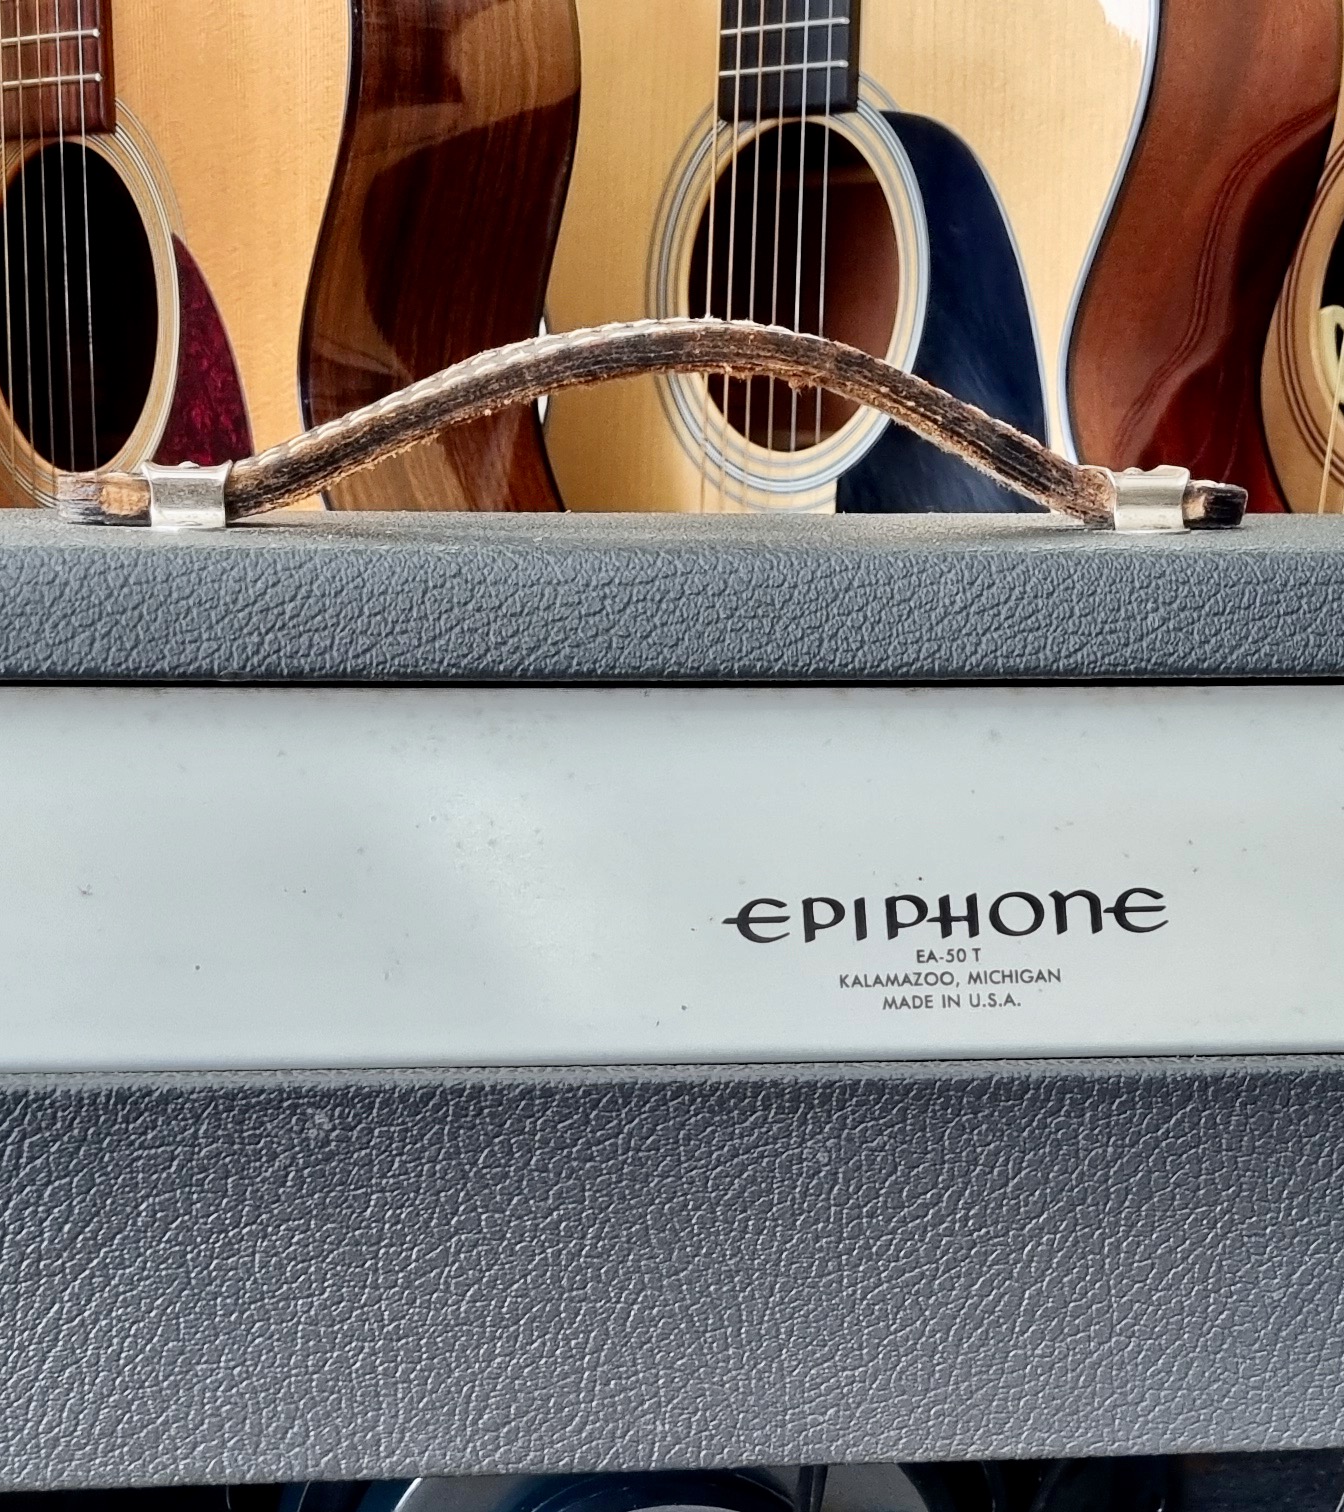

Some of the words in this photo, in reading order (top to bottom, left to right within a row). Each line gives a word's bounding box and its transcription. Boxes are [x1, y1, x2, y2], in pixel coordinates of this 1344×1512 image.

[721, 886, 1170, 944] EPIPHONE
[915, 947, 967, 965] EA-50
[971, 946, 982, 963] T
[839, 970, 961, 989] KALAMAZOO,
[967, 967, 1062, 986] MICHIGAN
[882, 994, 934, 1011] MADE
[941, 993, 961, 1009] IN
[968, 992, 1022, 1009] U.S.A.
